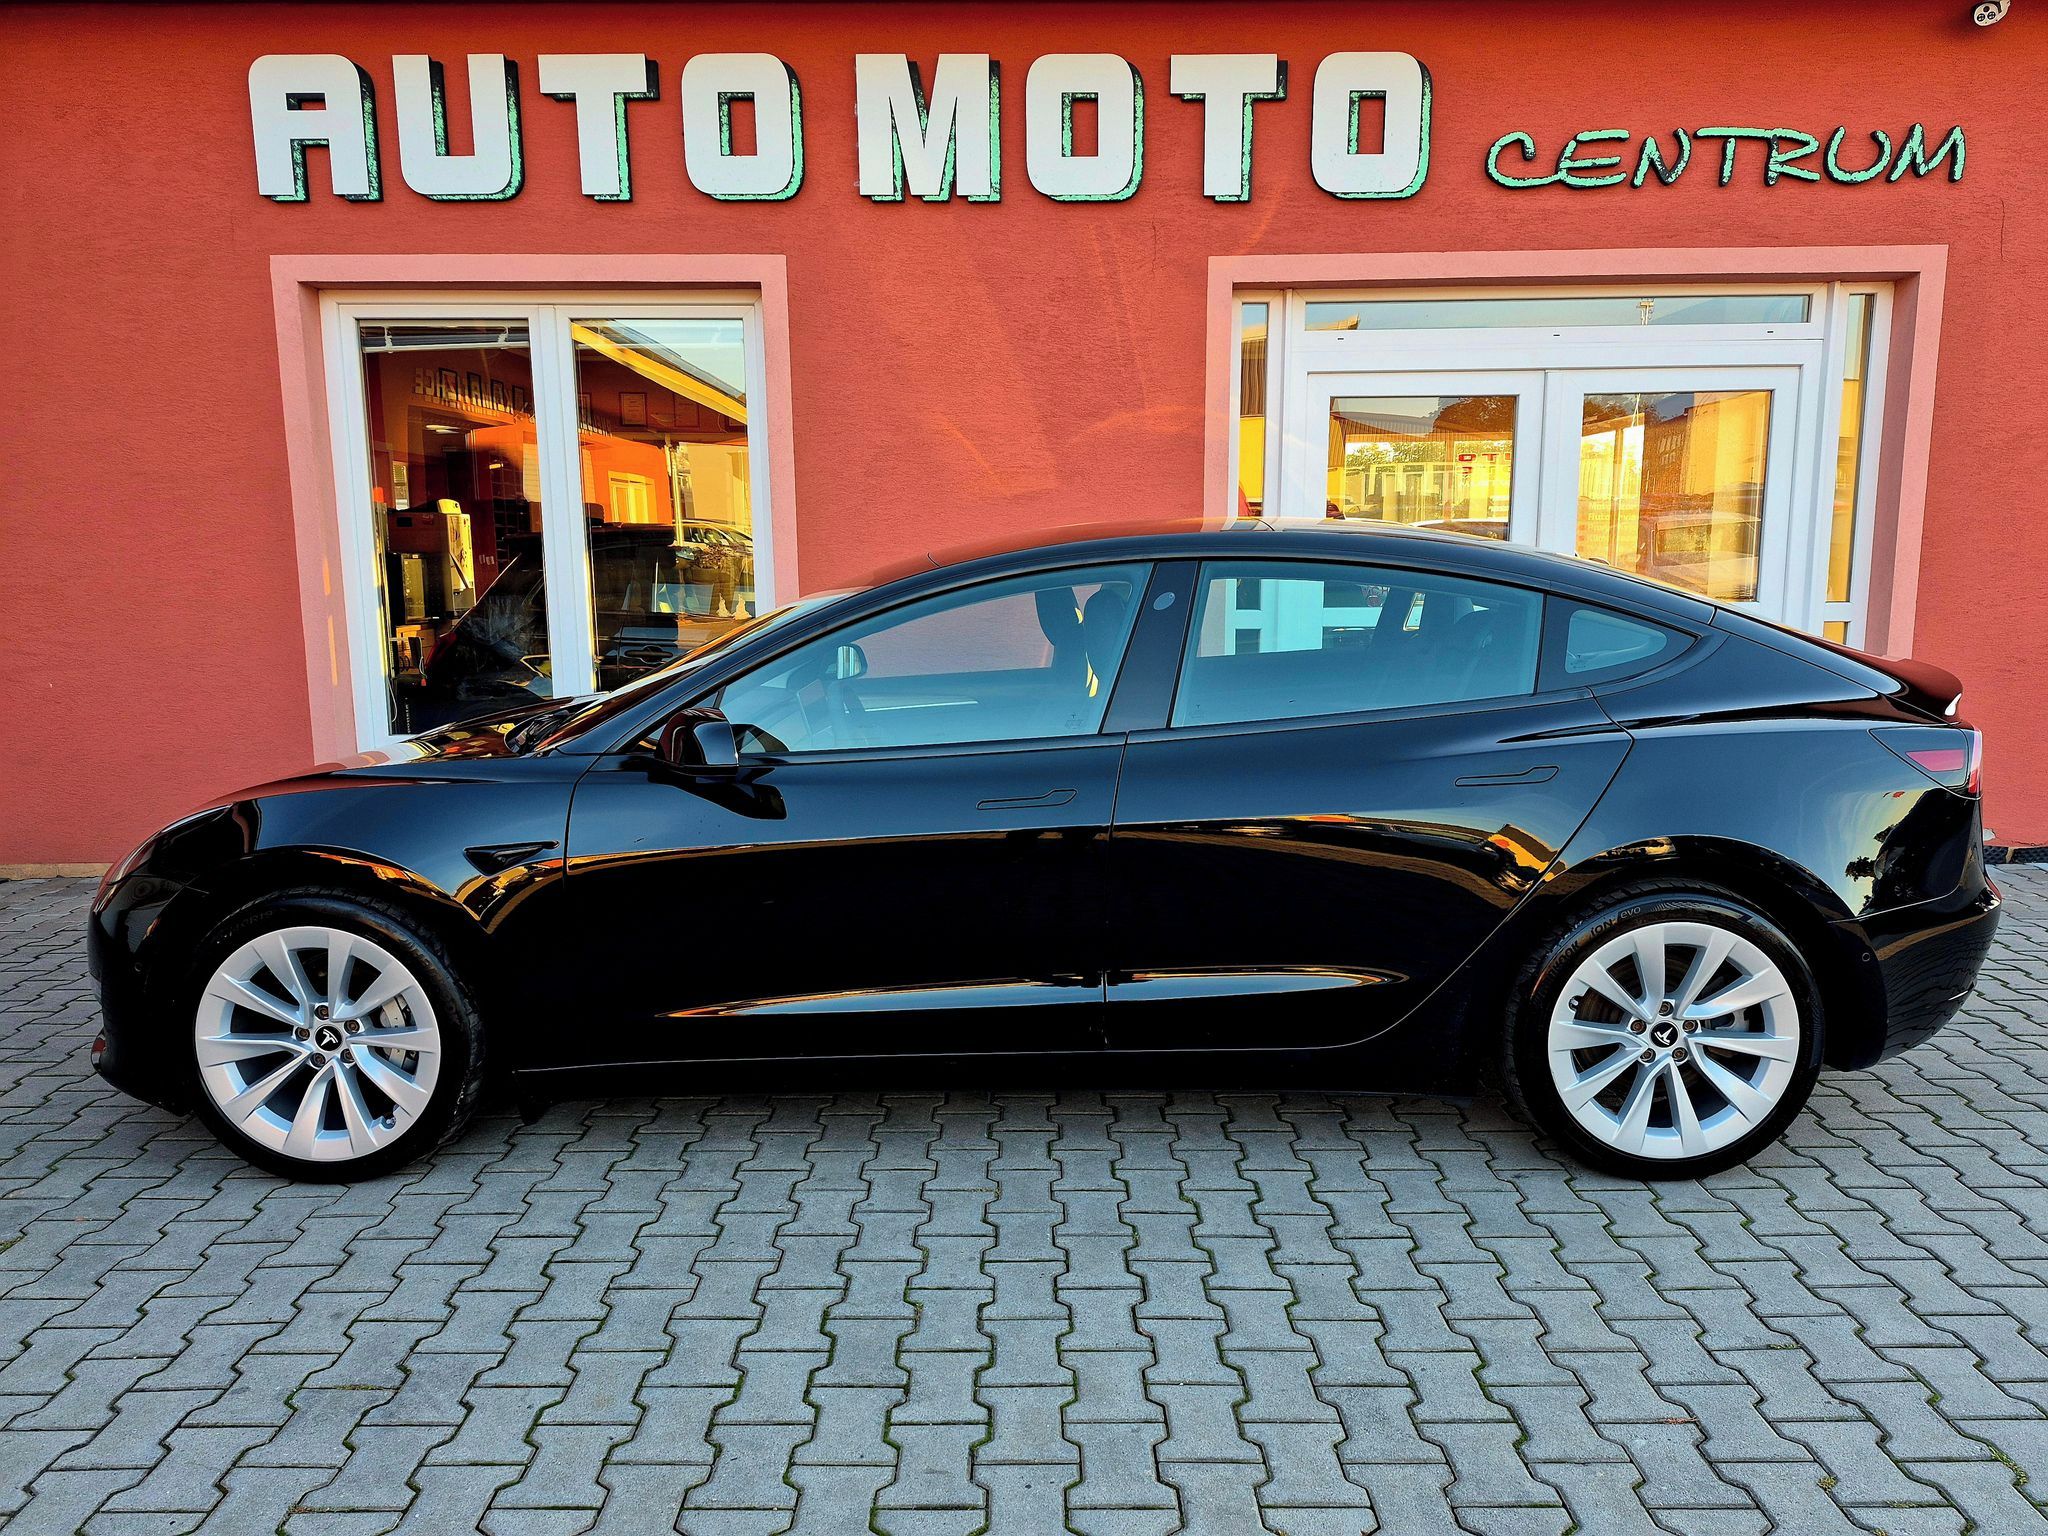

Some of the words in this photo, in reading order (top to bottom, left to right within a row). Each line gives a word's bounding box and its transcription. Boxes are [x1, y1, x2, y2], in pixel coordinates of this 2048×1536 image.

[248, 52, 802, 202] AUTO
[855, 50, 1432, 202] MOTO
[1486, 123, 1968, 189] CENTRUM
[1620, 906, 1641, 919] evo
